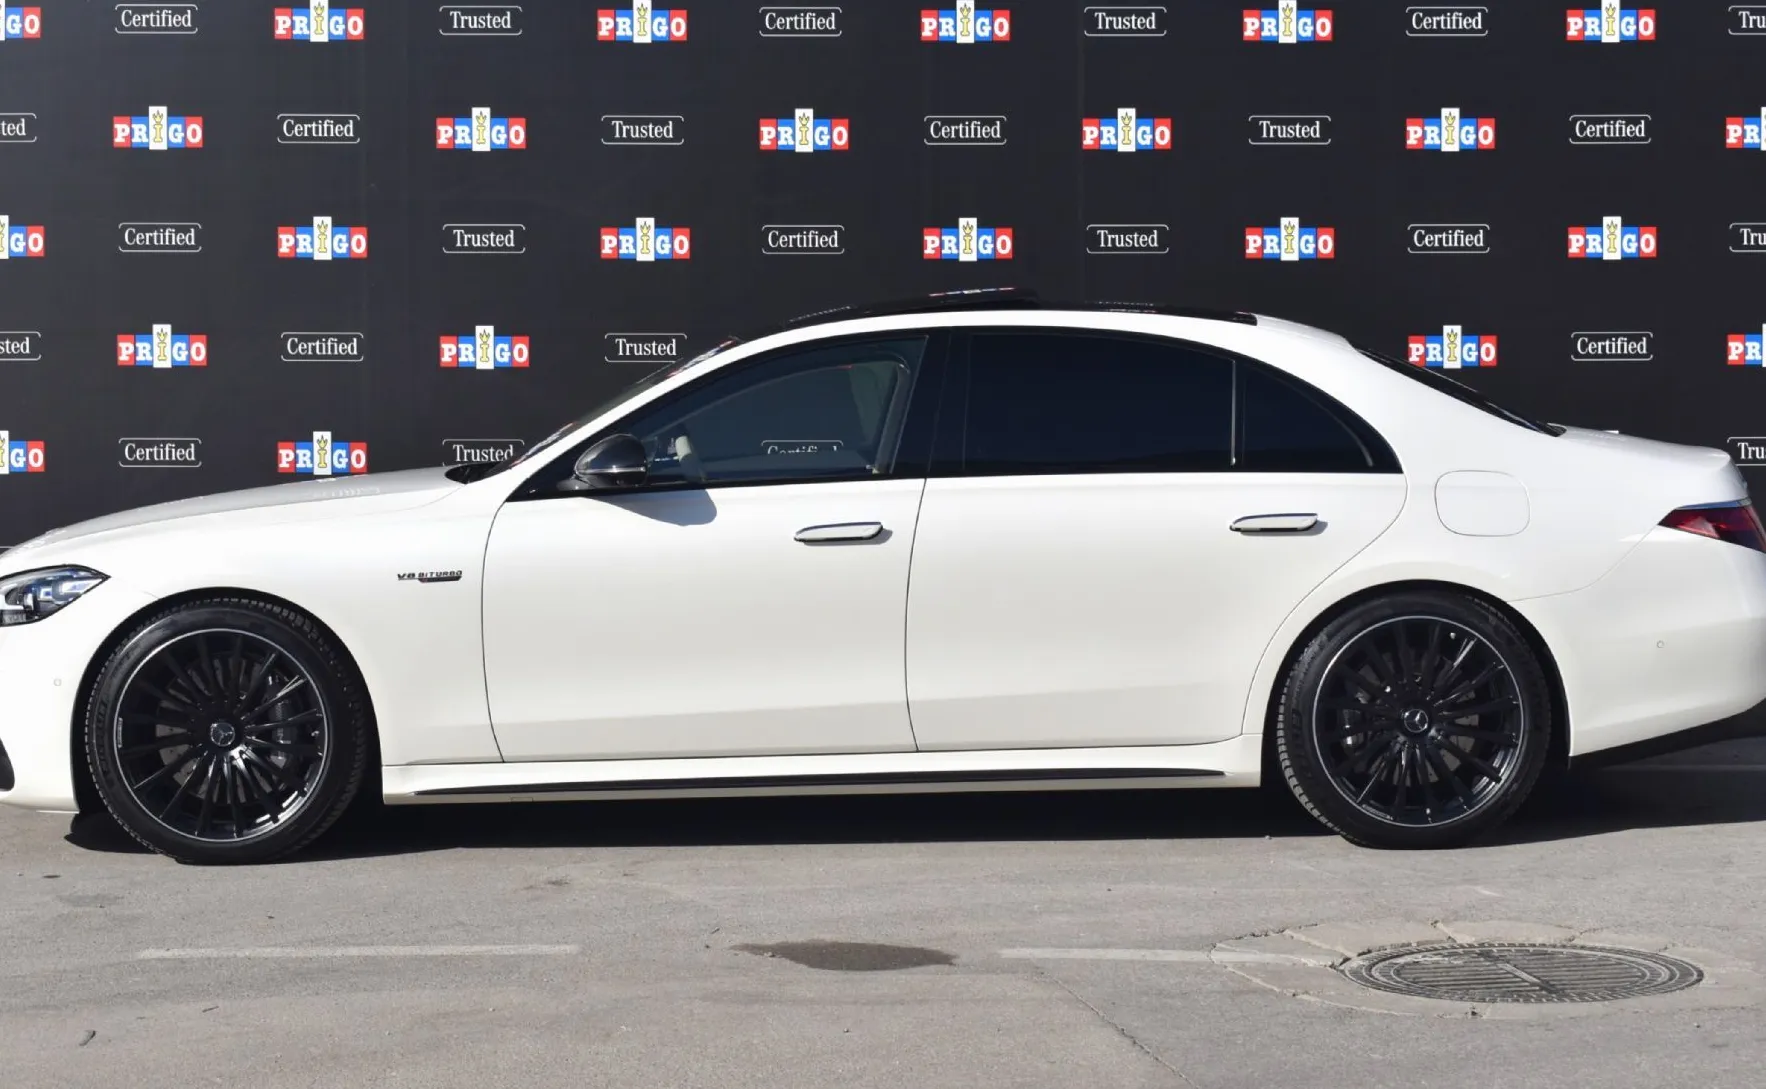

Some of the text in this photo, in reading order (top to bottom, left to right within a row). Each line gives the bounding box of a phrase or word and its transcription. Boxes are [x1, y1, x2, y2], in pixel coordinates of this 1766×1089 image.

[121, 10, 192, 28] Certified
[275, 3, 363, 35] PRIGO
[449, 11, 511, 29] Trusted
[598, 4, 686, 36] PRIGO
[765, 13, 836, 31] Certified
[922, 4, 1009, 36] PRIGO
[1094, 12, 1156, 30] Trusted
[1244, 4, 1331, 36] PRIGO
[1412, 13, 1483, 31] Certified
[1567, 4, 1654, 36] PRIGO
[114, 111, 202, 143] PRIGO
[283, 120, 354, 138] Certified
[437, 112, 525, 144] PRIGO
[612, 120, 674, 138] Trusted
[760, 113, 848, 145] PRIGO
[930, 122, 1001, 140] Certified
[1083, 113, 1170, 145] PRIGO
[1259, 121, 1321, 139] Trusted
[1407, 113, 1494, 145] PRIGO
[1575, 121, 1646, 139] Certified
[125, 229, 196, 247] Certified
[278, 221, 366, 253] PRIGO
[453, 229, 515, 247] Trusted
[601, 222, 689, 254] PRIGO
[768, 231, 839, 249] Certified
[924, 222, 1012, 254] PRIGO
[1097, 229, 1159, 247] Trusted
[1246, 222, 1333, 254] PRIGO
[1414, 230, 1485, 248] Certified
[1568, 221, 1656, 253] PRIGO
[118, 329, 206, 361] PRIGO
[287, 338, 358, 356] Certified
[441, 330, 528, 362] PRIGO
[615, 338, 677, 356] Trusted
[1409, 330, 1495, 362] PRIGO
[1577, 338, 1648, 356] Certified
[125, 444, 196, 462] Certified
[278, 436, 366, 468] PRIGO
[452, 444, 514, 462] Trusted
[1737, 442, 1766, 460] Tru
